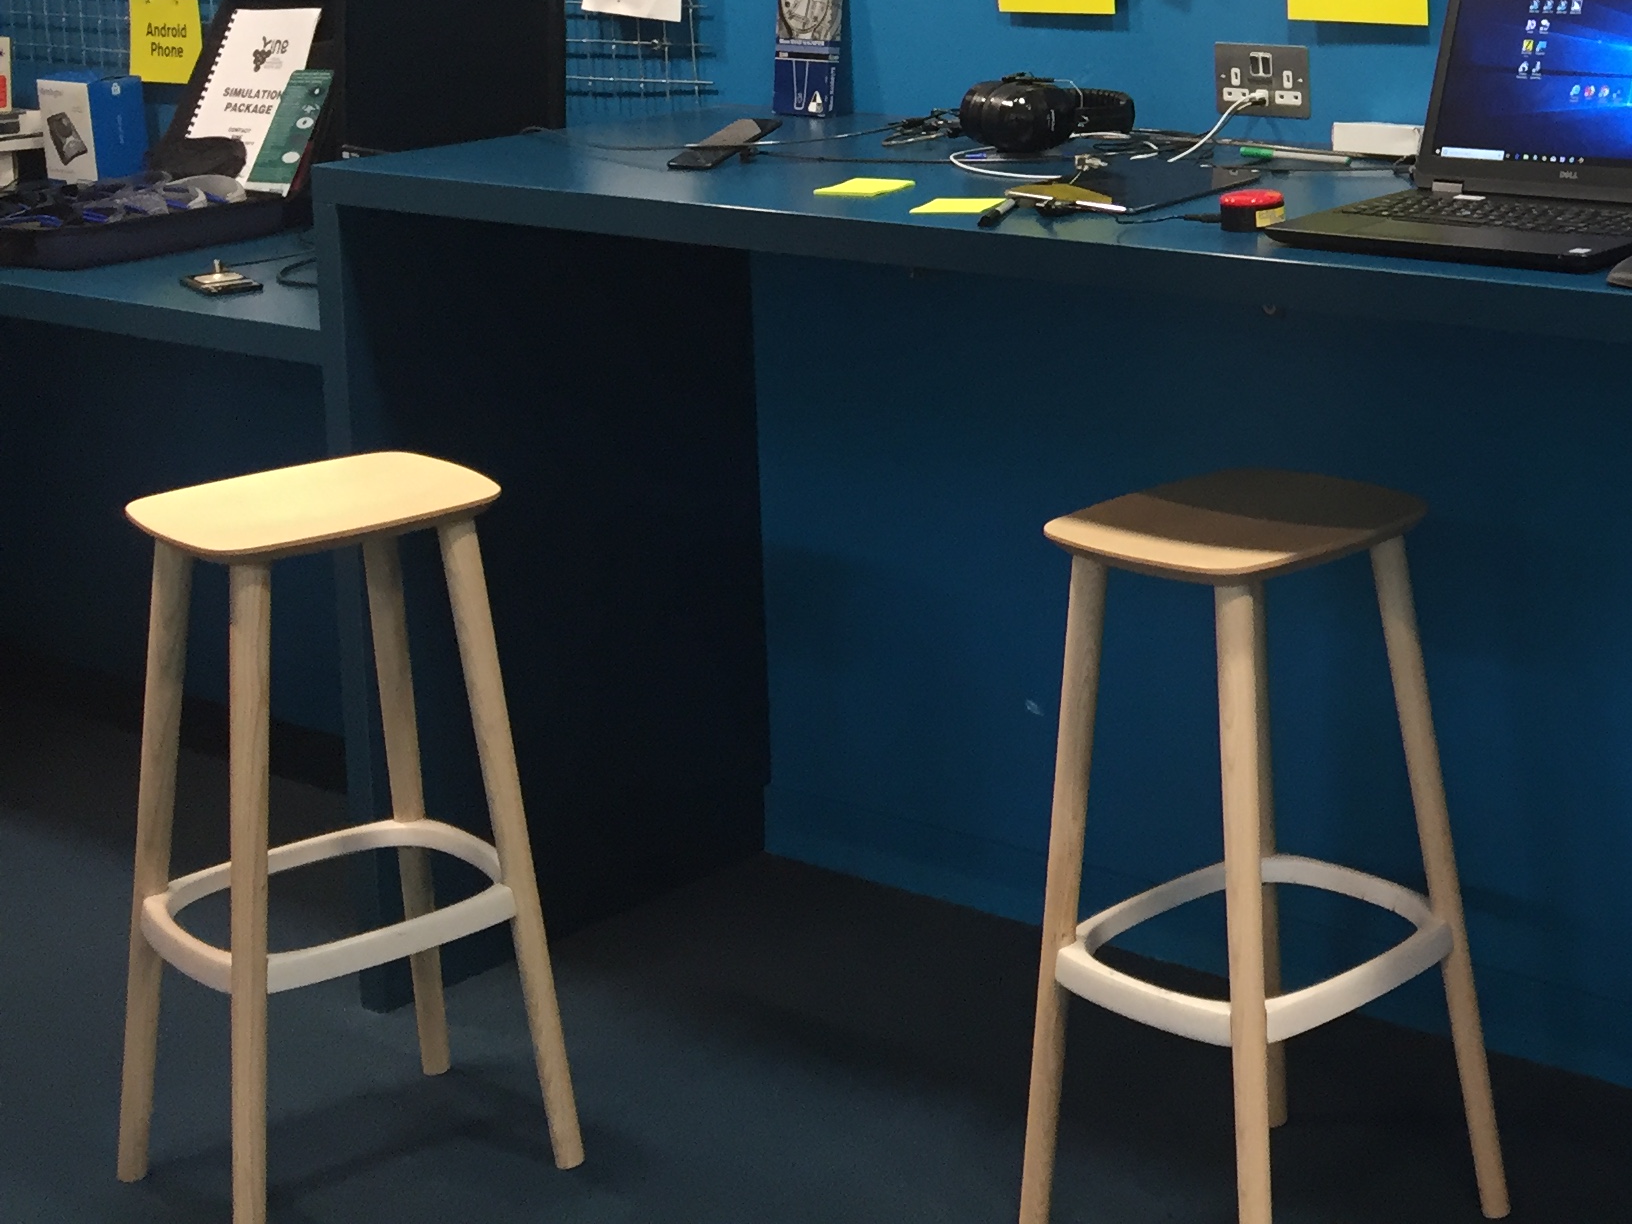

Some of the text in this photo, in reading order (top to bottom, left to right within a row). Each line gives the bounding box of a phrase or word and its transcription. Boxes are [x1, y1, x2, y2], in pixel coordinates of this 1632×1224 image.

[146, 22, 187, 39] Android
[150, 42, 184, 58] Phone
[224, 102, 273, 115] PACKAGE
